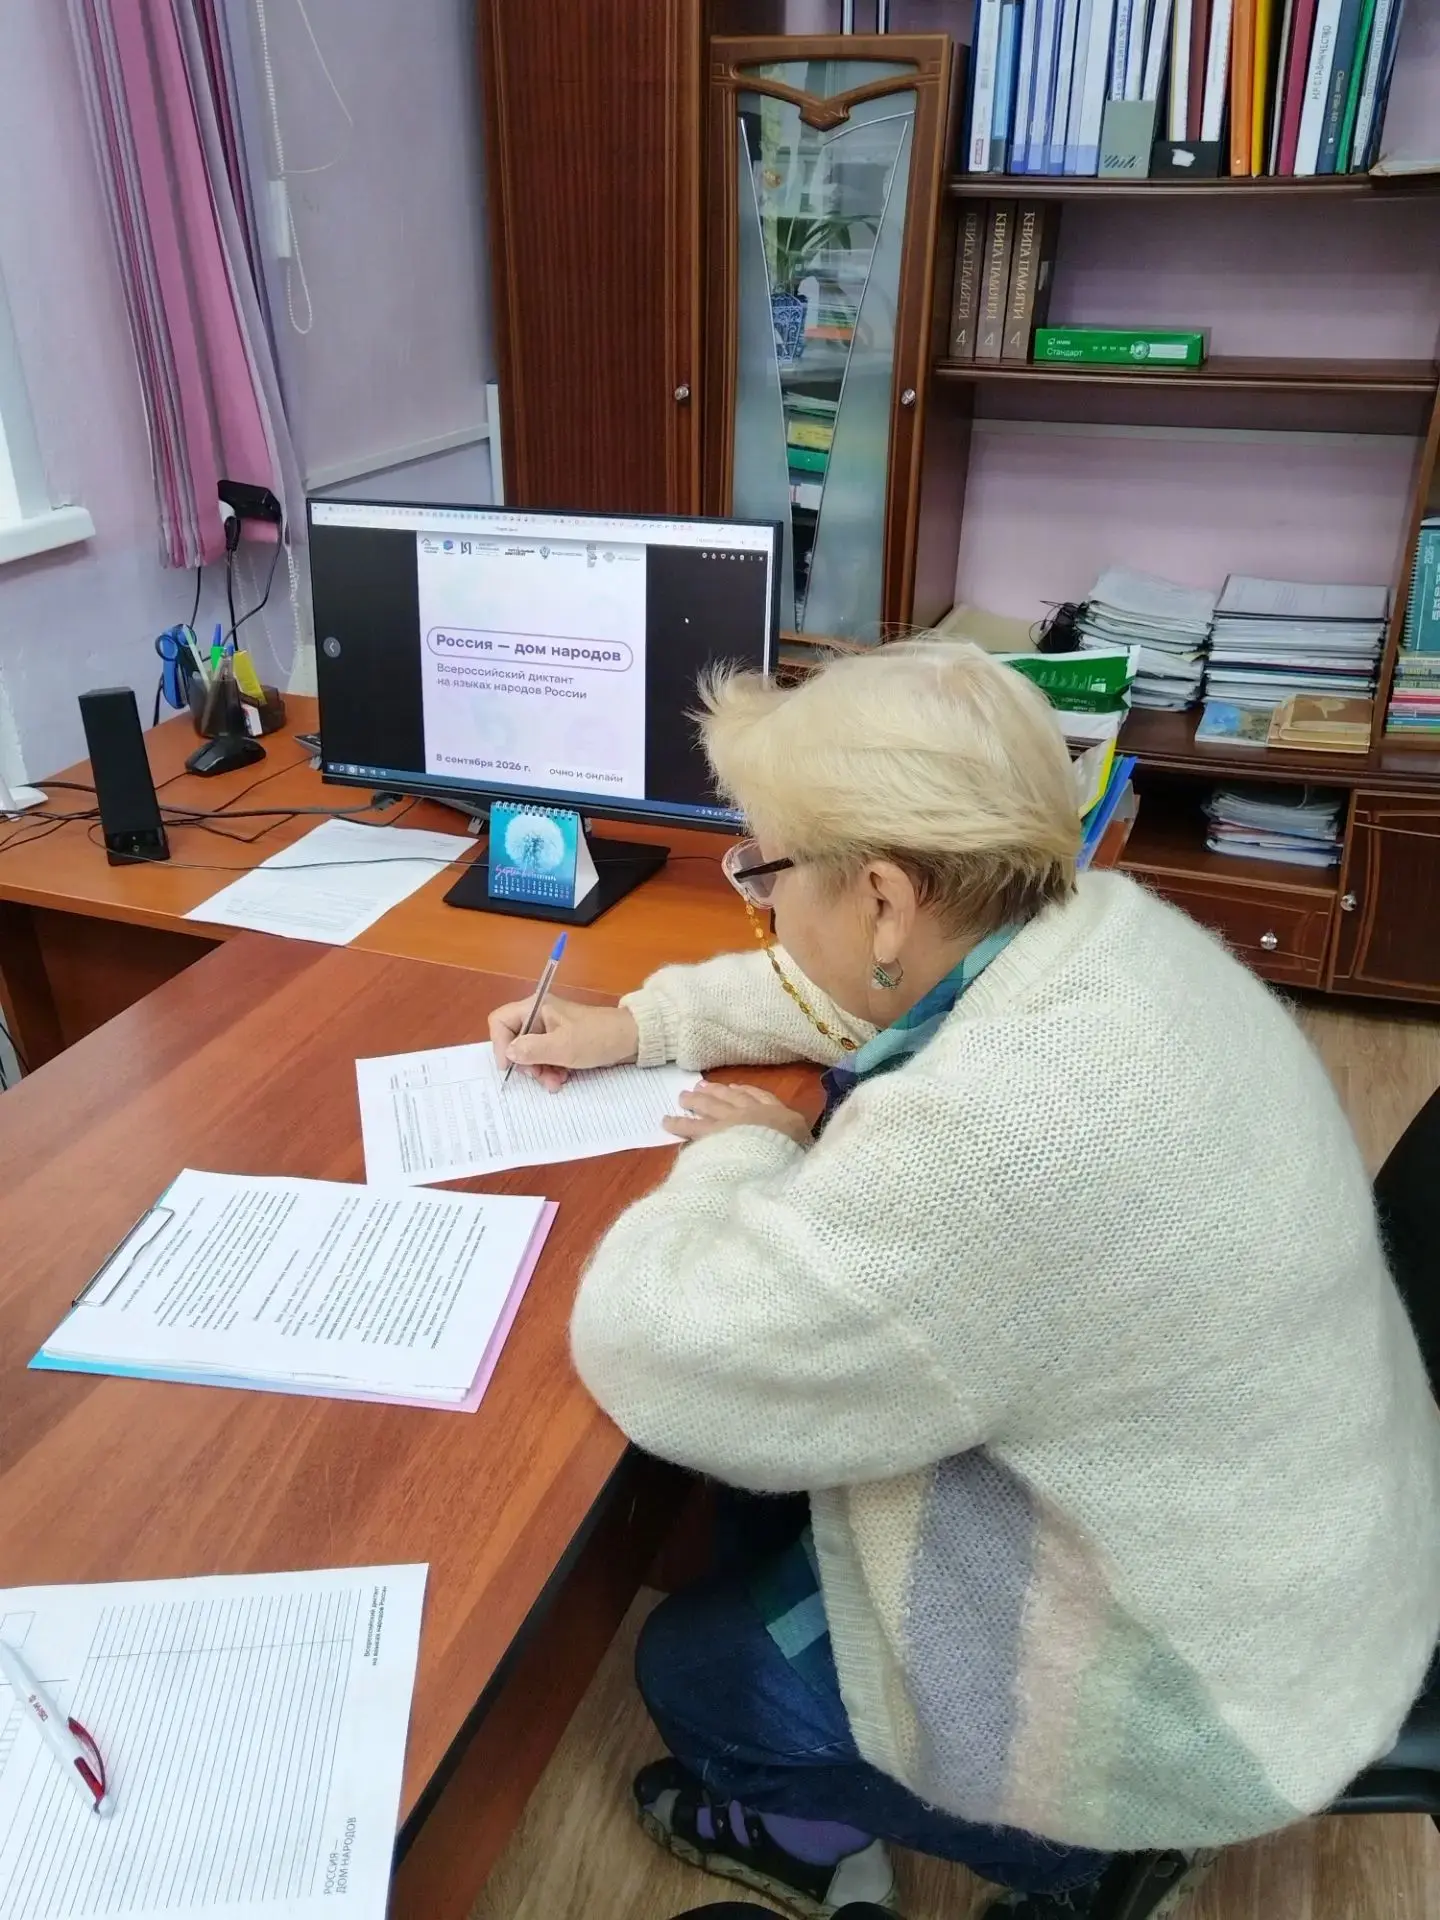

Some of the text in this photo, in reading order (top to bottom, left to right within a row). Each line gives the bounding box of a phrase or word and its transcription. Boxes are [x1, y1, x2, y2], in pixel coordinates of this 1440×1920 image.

[958, 213, 977, 320] КНИГА ПАМЯТИ
[986, 212, 1007, 320] КНИГА ПАМЯТИ
[1012, 212, 1035, 320] КНИГА ПАМЯТИ
[956, 329, 966, 345] 4
[984, 332, 994, 346] 4
[1010, 330, 1020, 347] 4
[1046, 348, 1083, 358] Стандарт
[436, 634, 492, 650] Россия
[514, 644, 546, 656] дом
[552, 646, 621, 662] народов
[437, 663, 574, 686] Всероссийский диктант
[438, 678, 587, 700] на языках народов России
[445, 756, 494, 768] сентября
[524, 764, 531, 773] г.
[550, 768, 574, 778] очно
[585, 772, 624, 783] онлайн
[364, 1586, 380, 1657] Всероссийский диктант
[376, 1606, 384, 1632] народов
[380, 1586, 388, 1606] России
[336, 1816, 356, 1894] ДОМ НАРОДОВ
[324, 1852, 338, 1895] РОССИЯ
